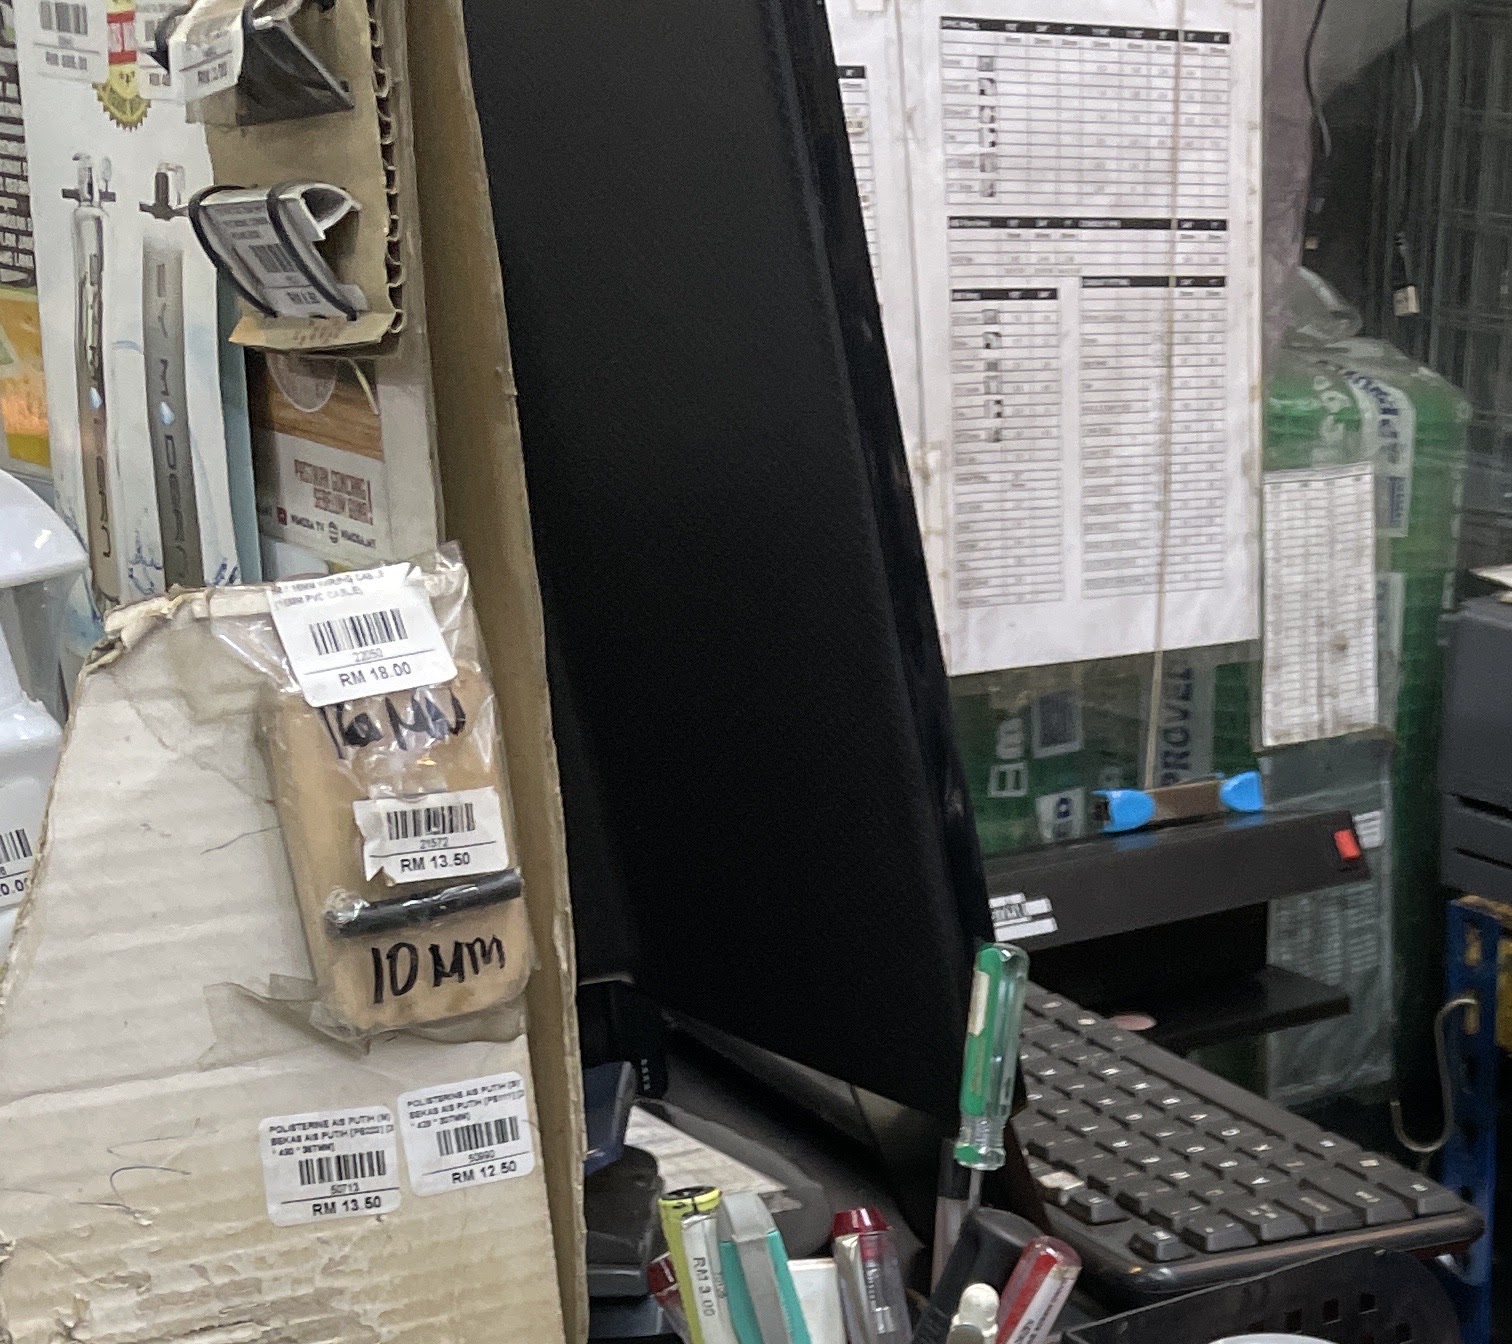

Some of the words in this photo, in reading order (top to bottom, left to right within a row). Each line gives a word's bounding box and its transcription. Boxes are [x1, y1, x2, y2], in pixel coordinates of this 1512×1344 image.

[338, 670, 367, 688] RM
[369, 661, 412, 683] 18.00
[400, 856, 426, 873] RM
[429, 851, 471, 869] 13.50
[371, 941, 420, 1004] 10
[451, 1169, 475, 1185] RM
[479, 1160, 518, 1178] 12.50
[311, 1201, 337, 1217] RM
[341, 1195, 382, 1213] 13.50
[692, 1256, 708, 1282] RM
